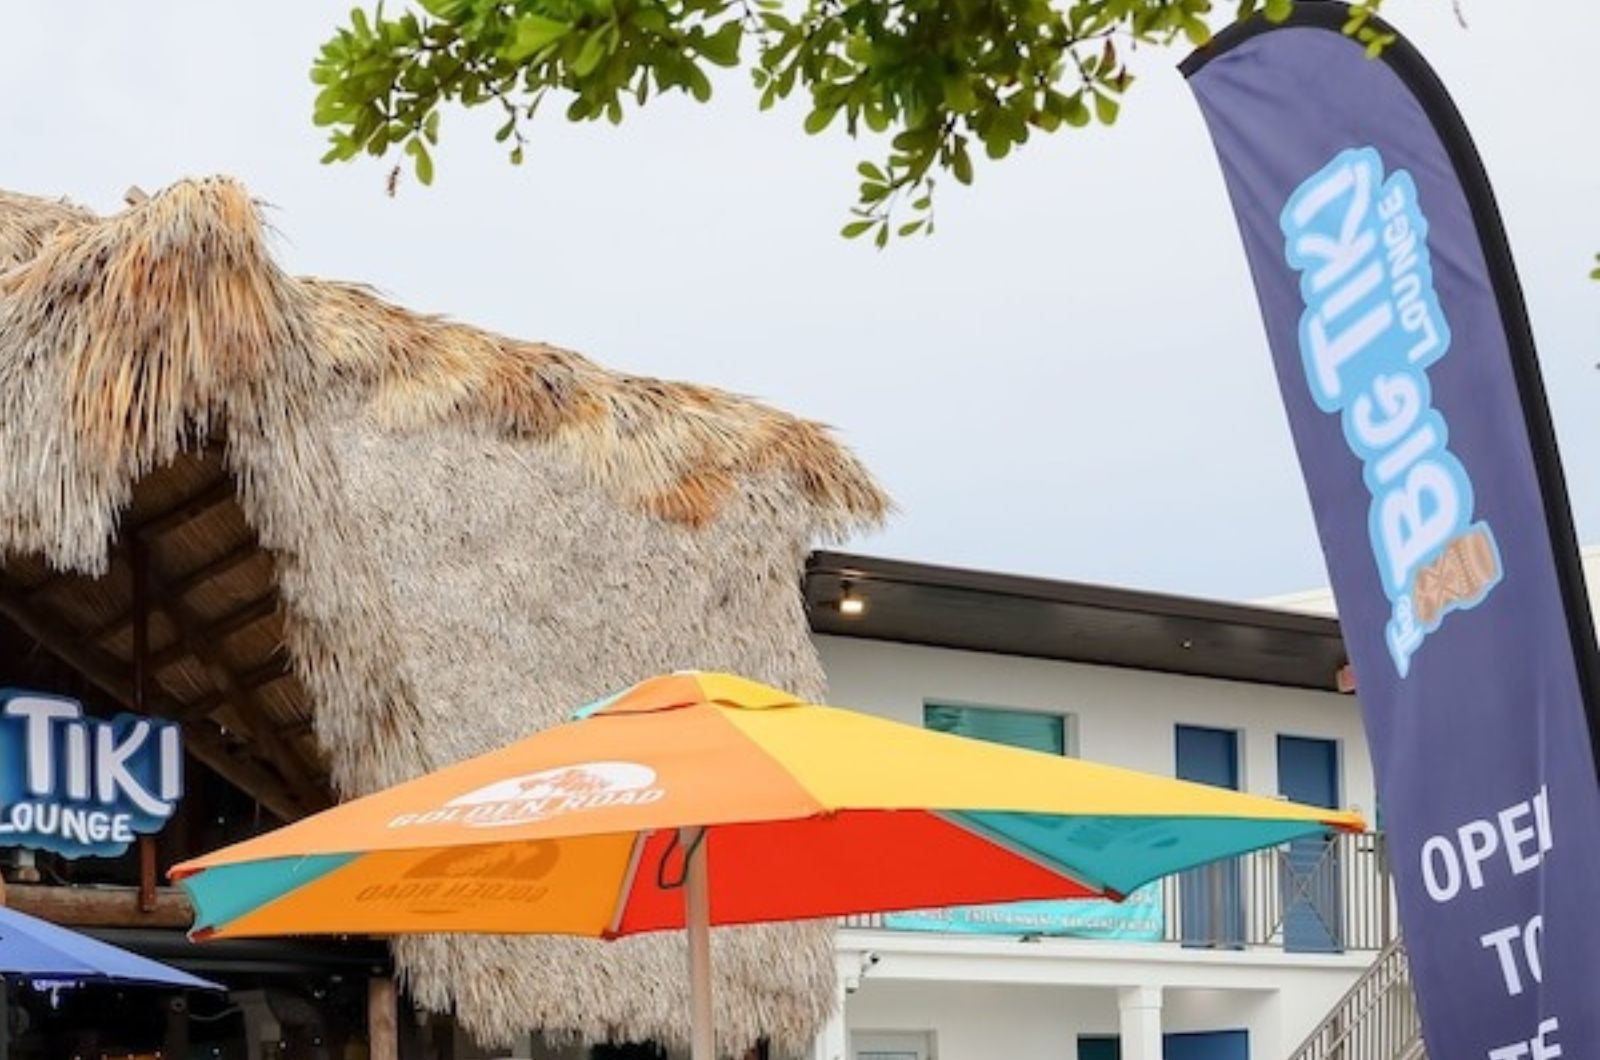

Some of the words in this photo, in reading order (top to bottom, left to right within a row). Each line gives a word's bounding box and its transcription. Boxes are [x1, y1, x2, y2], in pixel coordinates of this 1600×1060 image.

[1294, 162, 1393, 398] TIKI
[1379, 186, 1440, 363] LOUNGE
[1353, 374, 1460, 589] BIG
[5, 697, 182, 816] TIKI
[555, 788, 666, 811] ROAD
